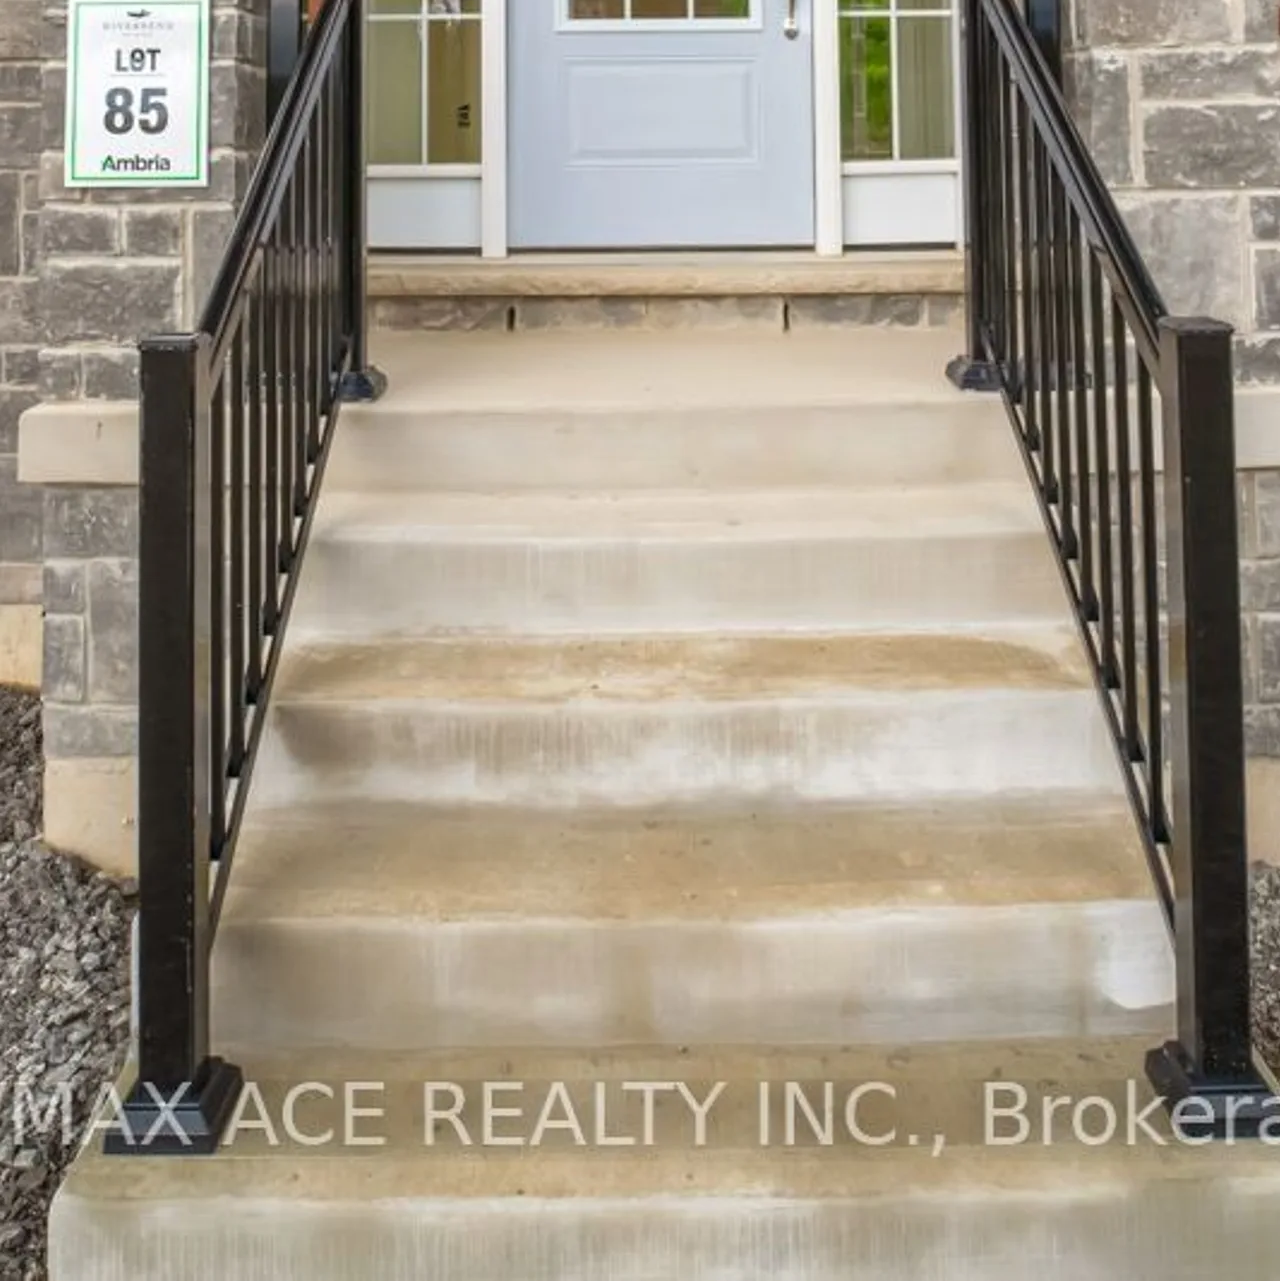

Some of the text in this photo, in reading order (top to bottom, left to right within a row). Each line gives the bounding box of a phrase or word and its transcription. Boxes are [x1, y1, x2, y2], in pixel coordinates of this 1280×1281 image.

[115, 48, 161, 73] LOT
[103, 86, 169, 135] 85
[101, 154, 171, 172] Ambria
